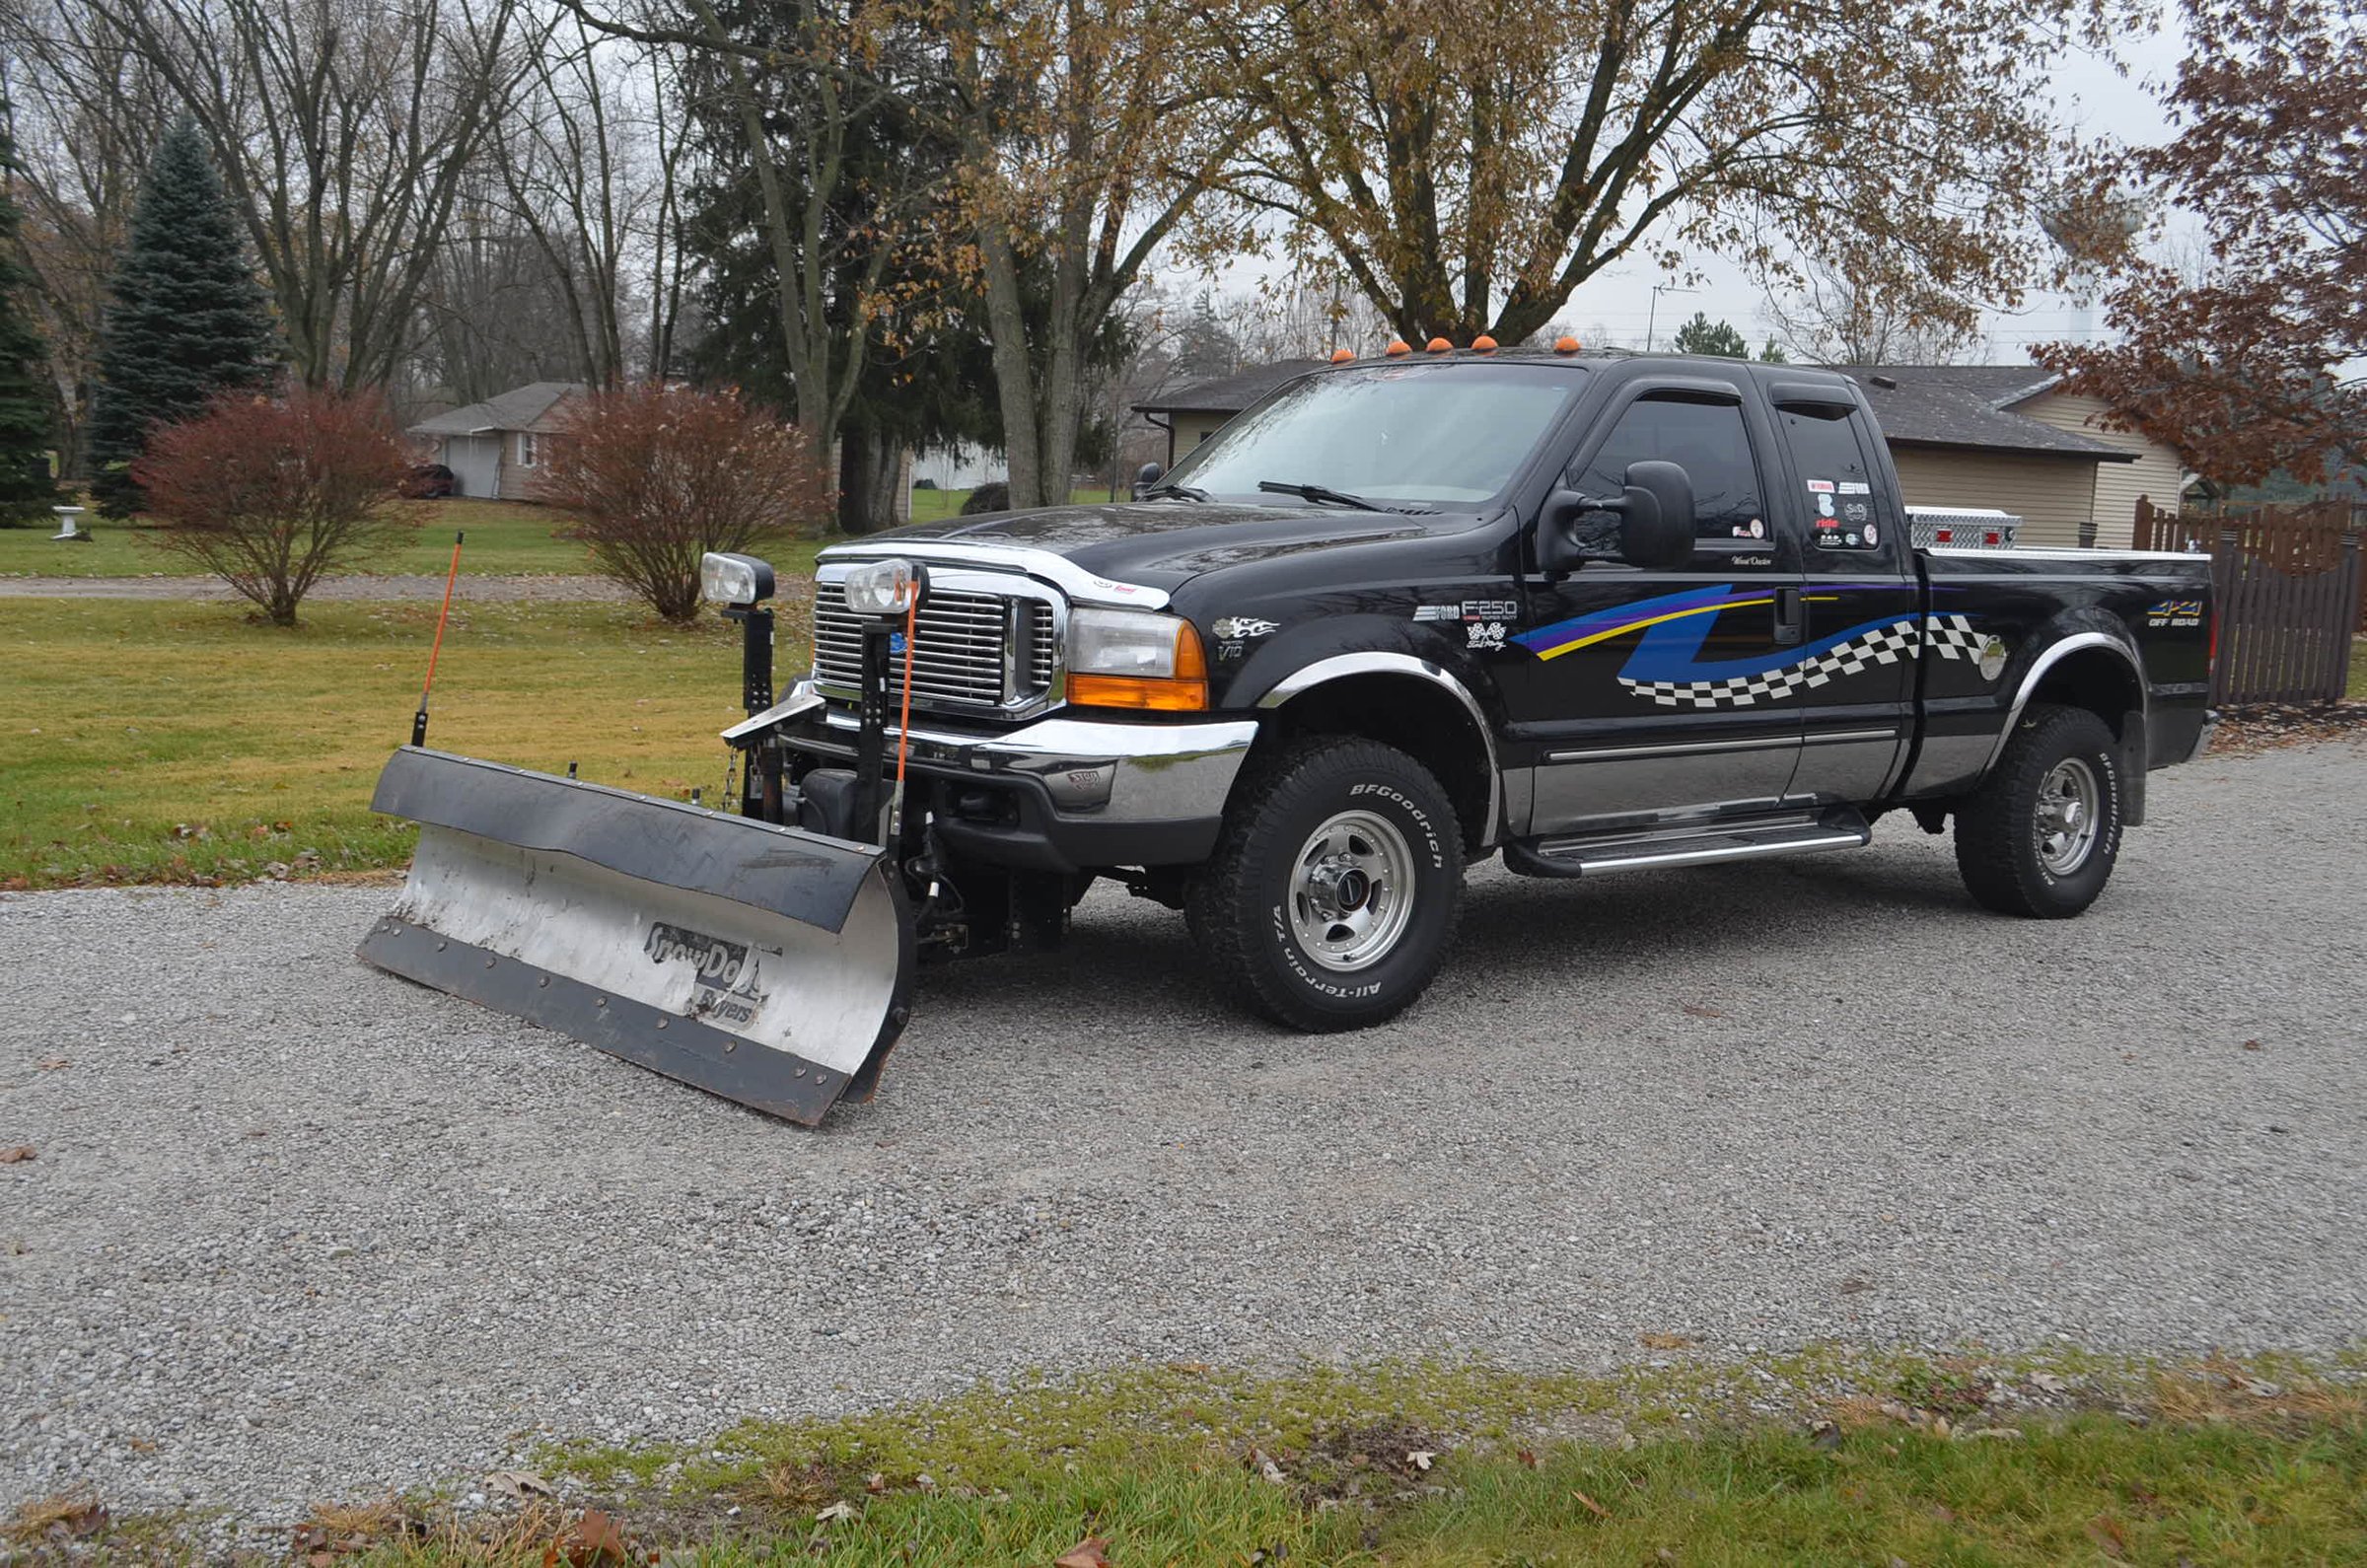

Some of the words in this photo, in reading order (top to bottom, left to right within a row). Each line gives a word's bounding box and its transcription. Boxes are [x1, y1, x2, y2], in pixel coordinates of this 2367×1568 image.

[2149, 618, 2169, 627] OFF
[2171, 618, 2199, 627] ROAD
[1350, 783, 1443, 869] BFGoodrich
[1272, 904, 1286, 944] T/A
[1283, 947, 1382, 998] All-Terrain
